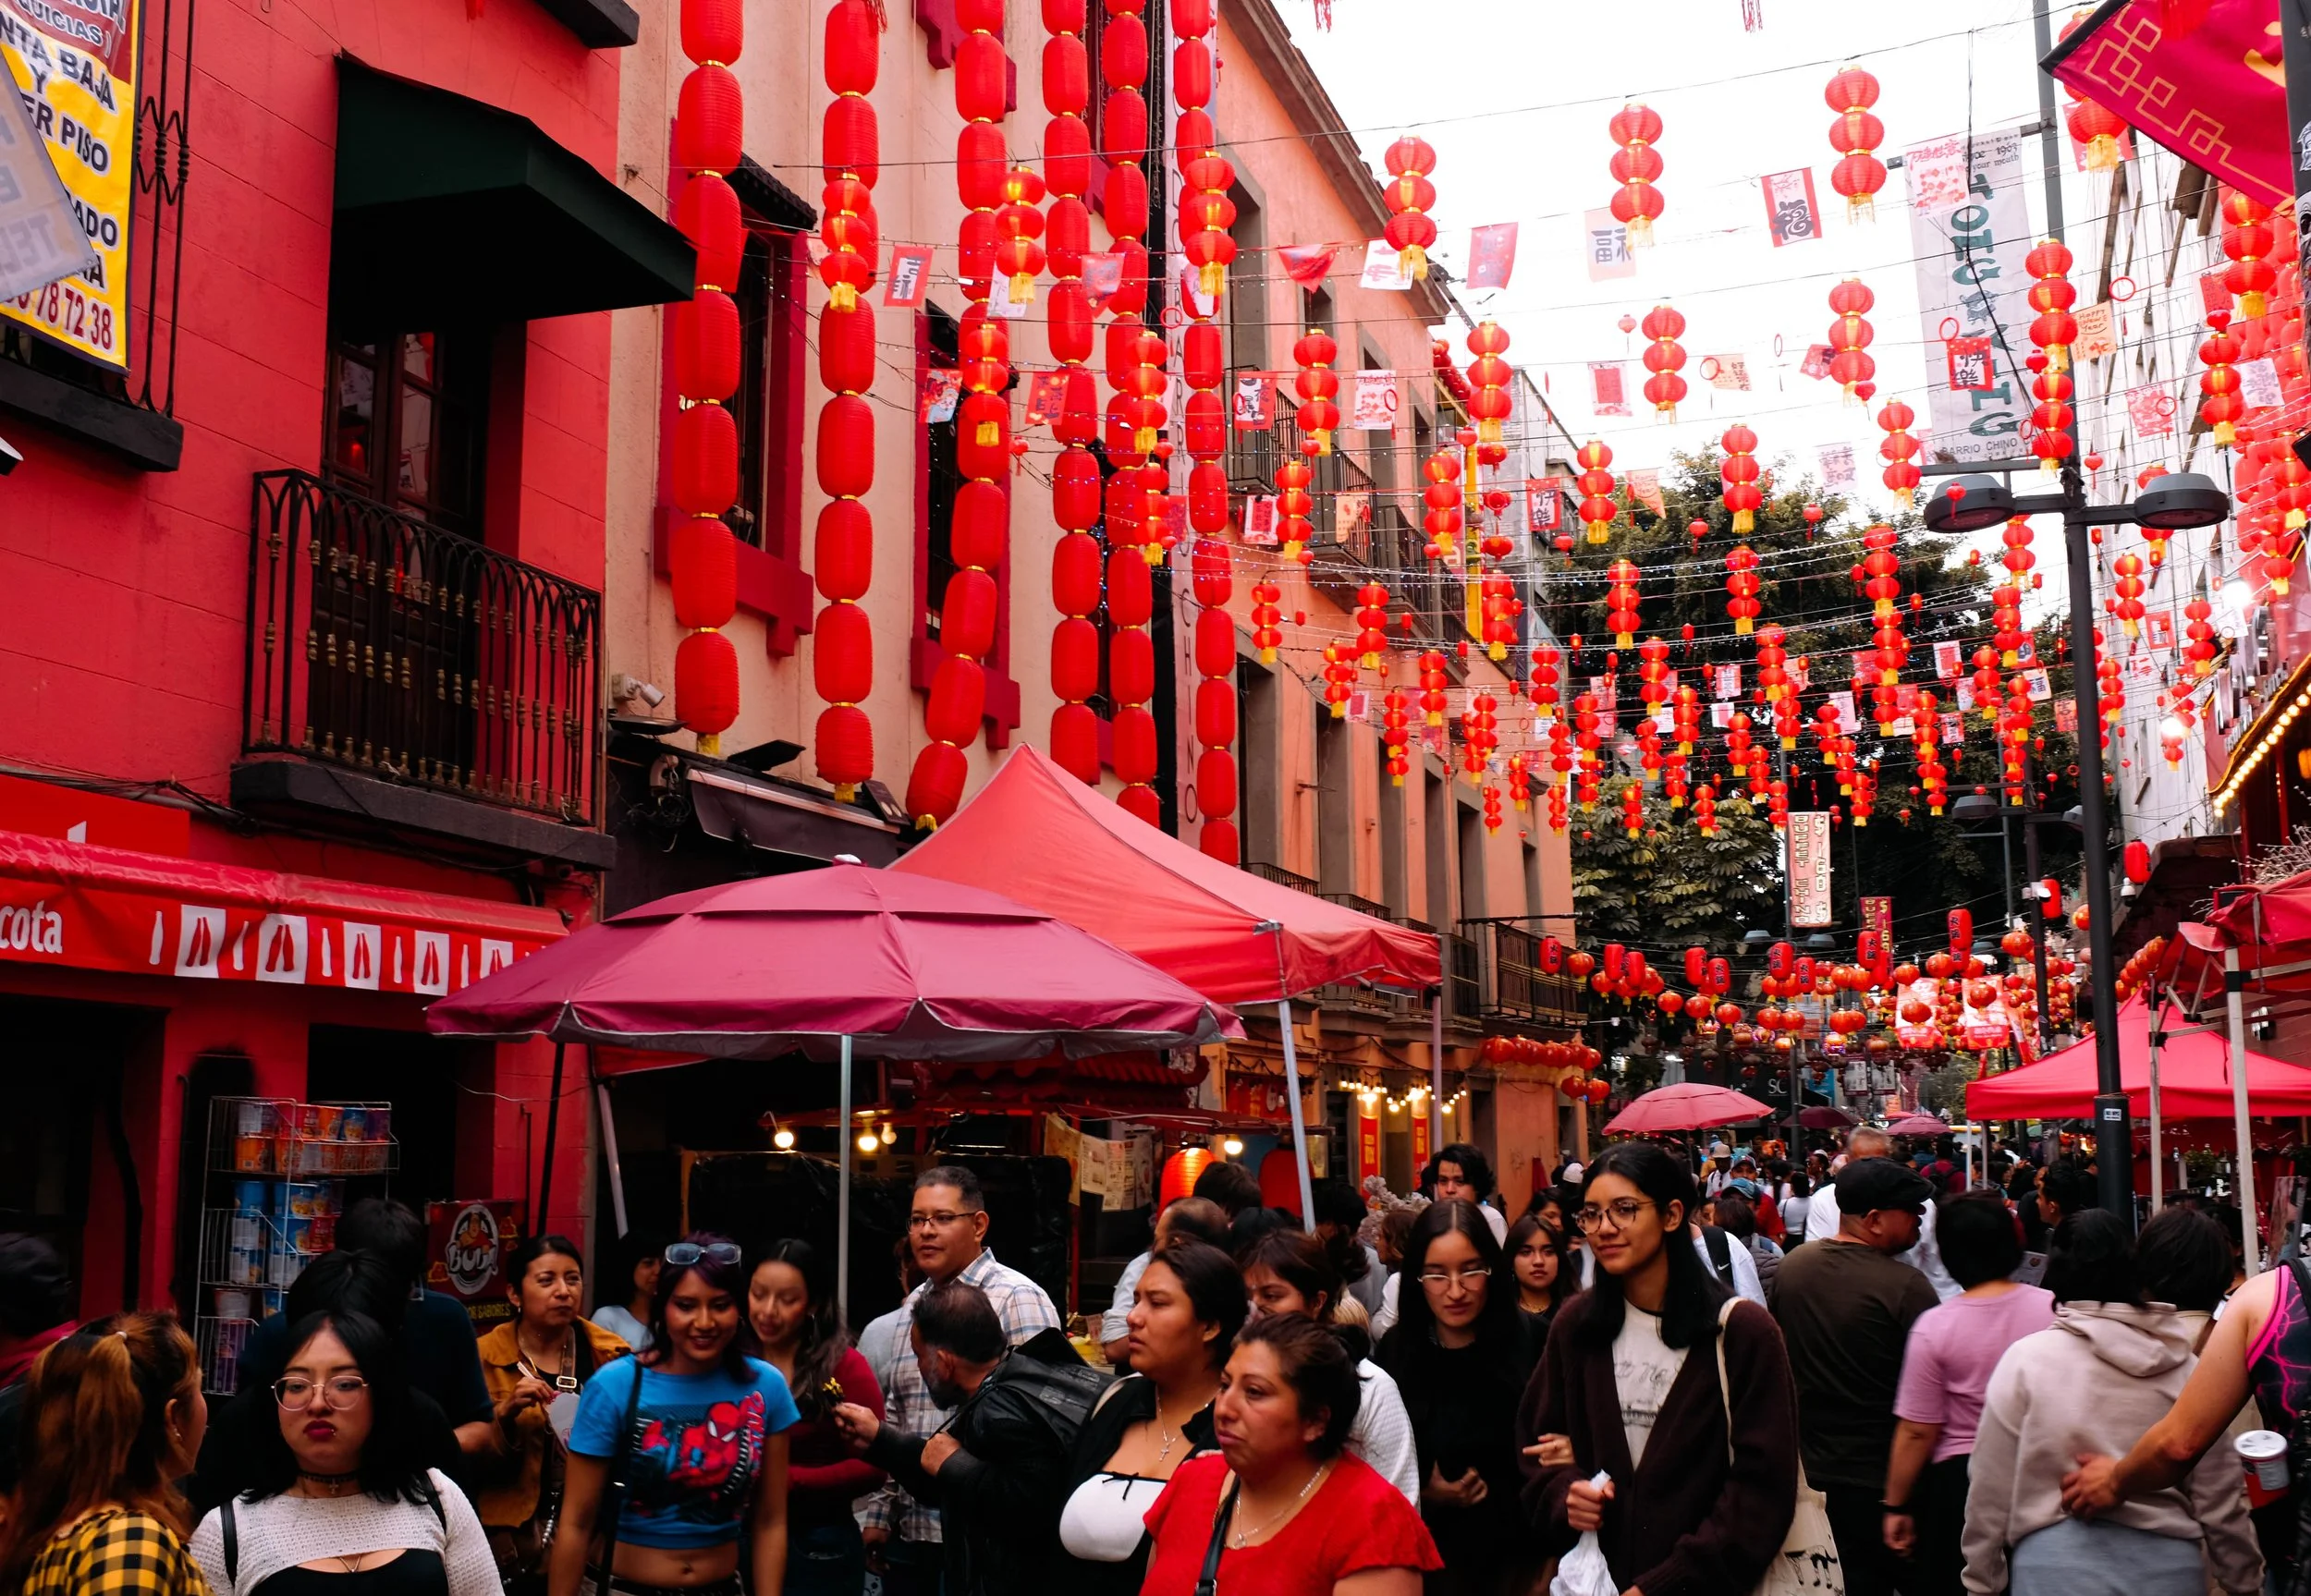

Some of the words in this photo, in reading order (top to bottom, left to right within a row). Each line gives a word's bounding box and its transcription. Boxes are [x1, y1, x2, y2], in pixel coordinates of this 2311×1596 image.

[30, 64, 46, 93] Y
[59, 49, 116, 111] BAJA
[62, 116, 108, 173] PISO
[66, 189, 117, 248] ADO
[66, 288, 84, 338] 72
[92, 303, 112, 350] 38
[1987, 437, 2018, 451] CHINO
[1180, 588, 1198, 823] CHINO
[1794, 815, 1809, 867] BUFFET
